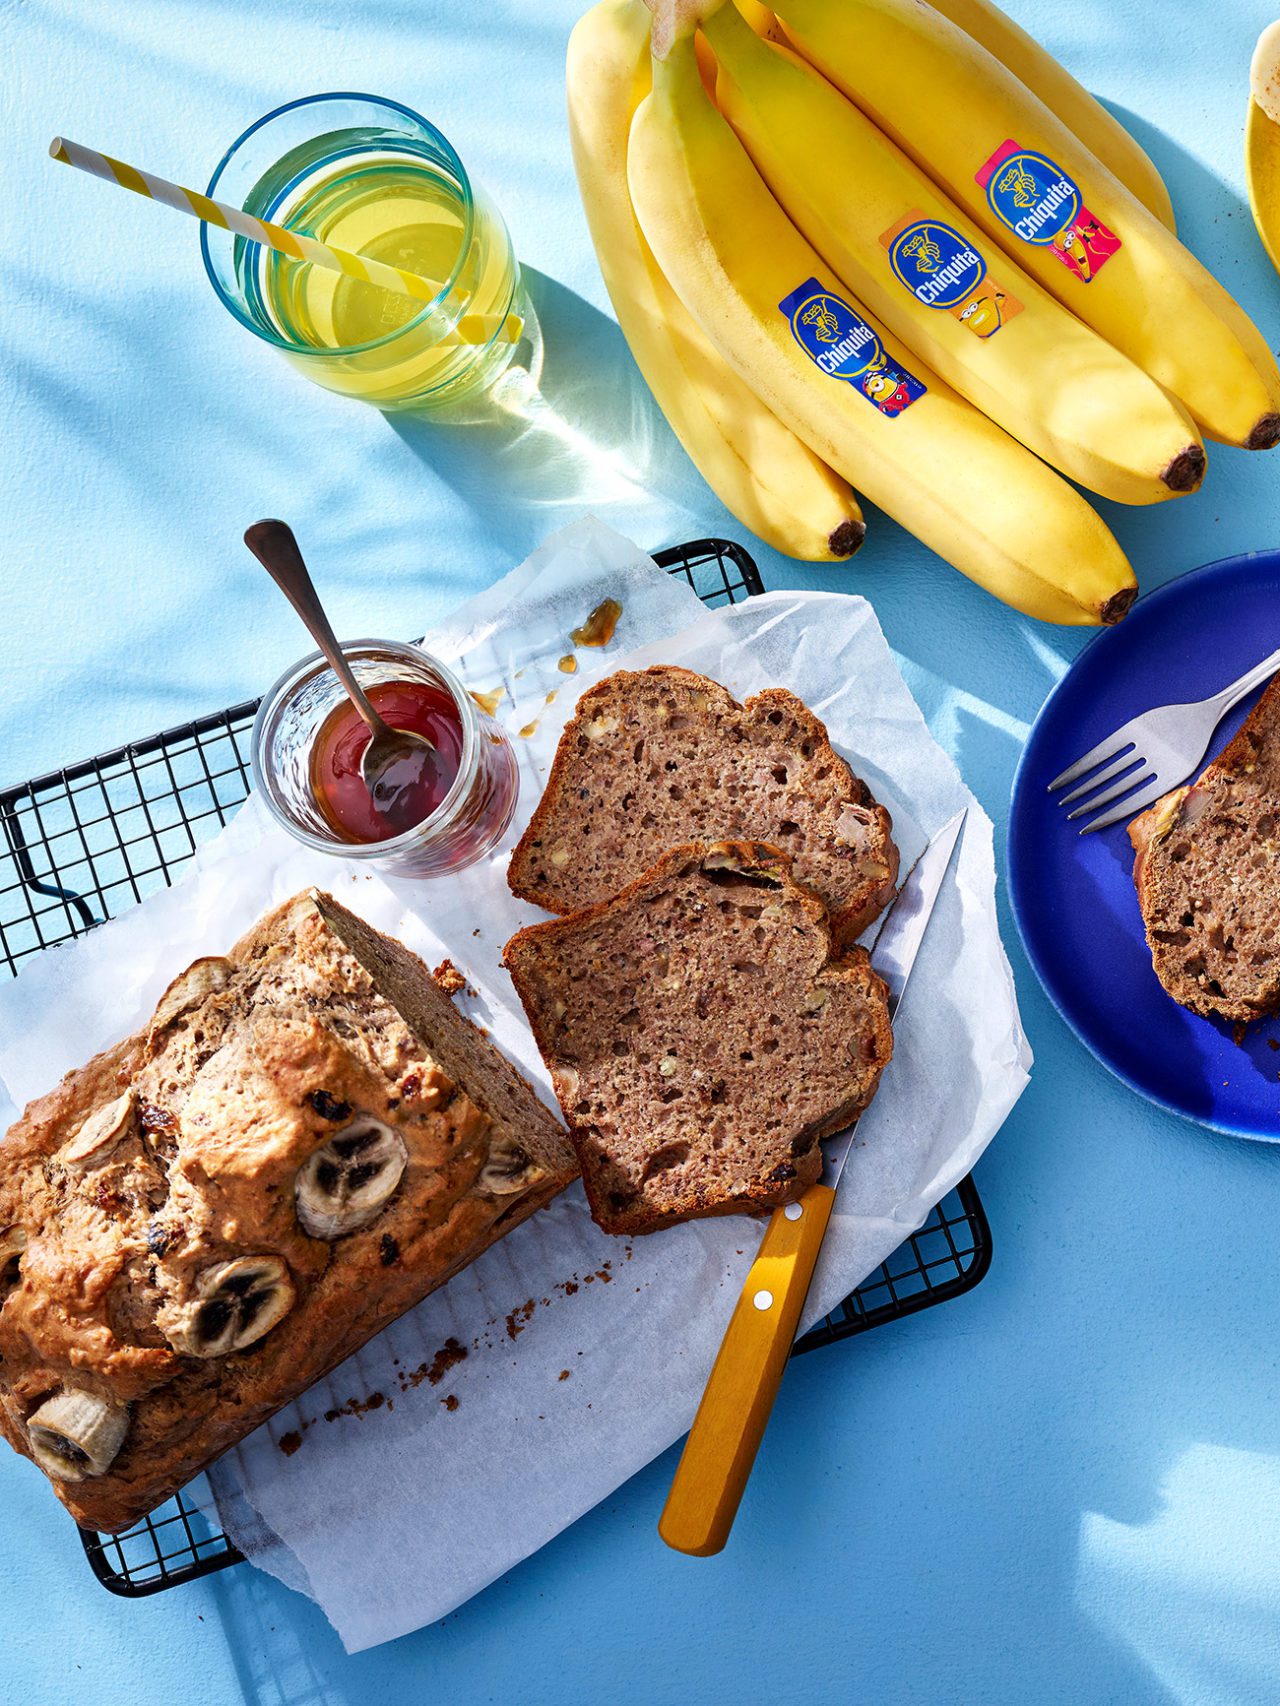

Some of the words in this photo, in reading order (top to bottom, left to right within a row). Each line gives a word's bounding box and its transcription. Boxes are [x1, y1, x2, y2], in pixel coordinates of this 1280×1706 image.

[1014, 176, 1075, 241] Chiquita
[915, 247, 980, 305] Chiquita
[816, 322, 876, 376] Chiquita
